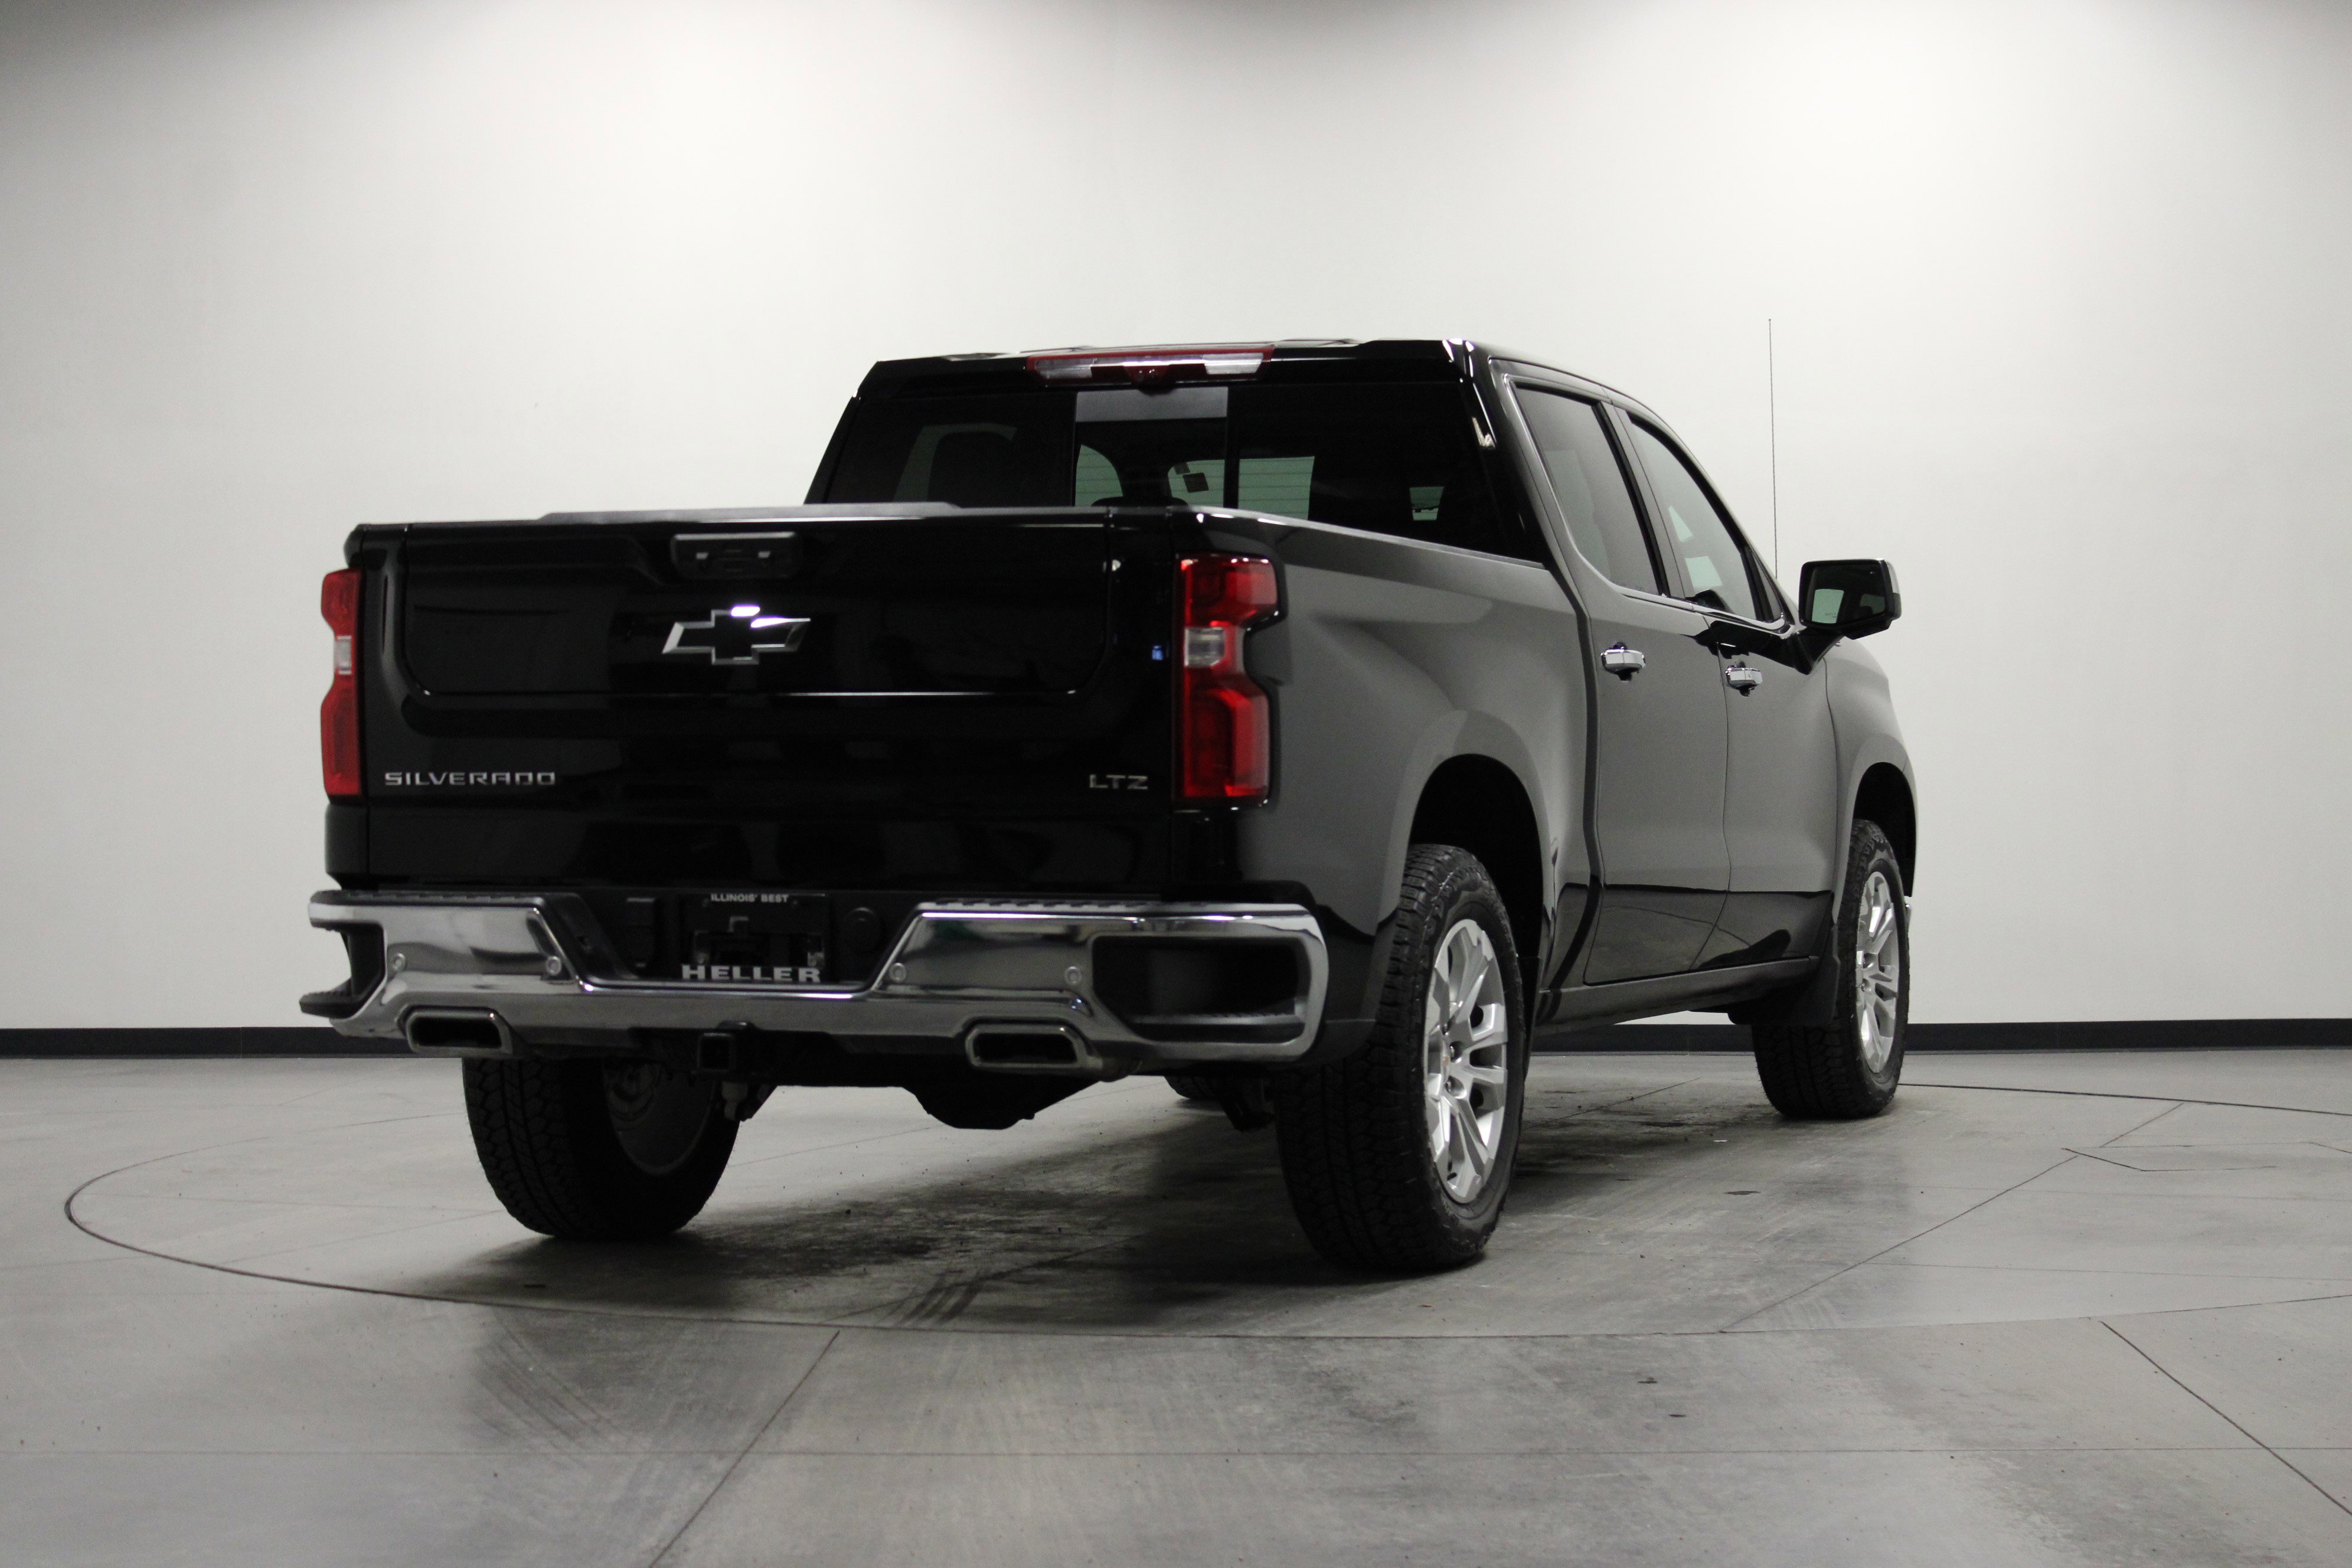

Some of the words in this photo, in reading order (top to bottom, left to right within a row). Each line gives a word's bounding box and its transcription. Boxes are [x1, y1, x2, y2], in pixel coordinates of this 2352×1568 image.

[385, 772, 556, 786] SILVERADO
[1089, 775, 1148, 789] LTZ
[760, 893, 789, 903] BEST
[681, 964, 821, 983] HELLER
